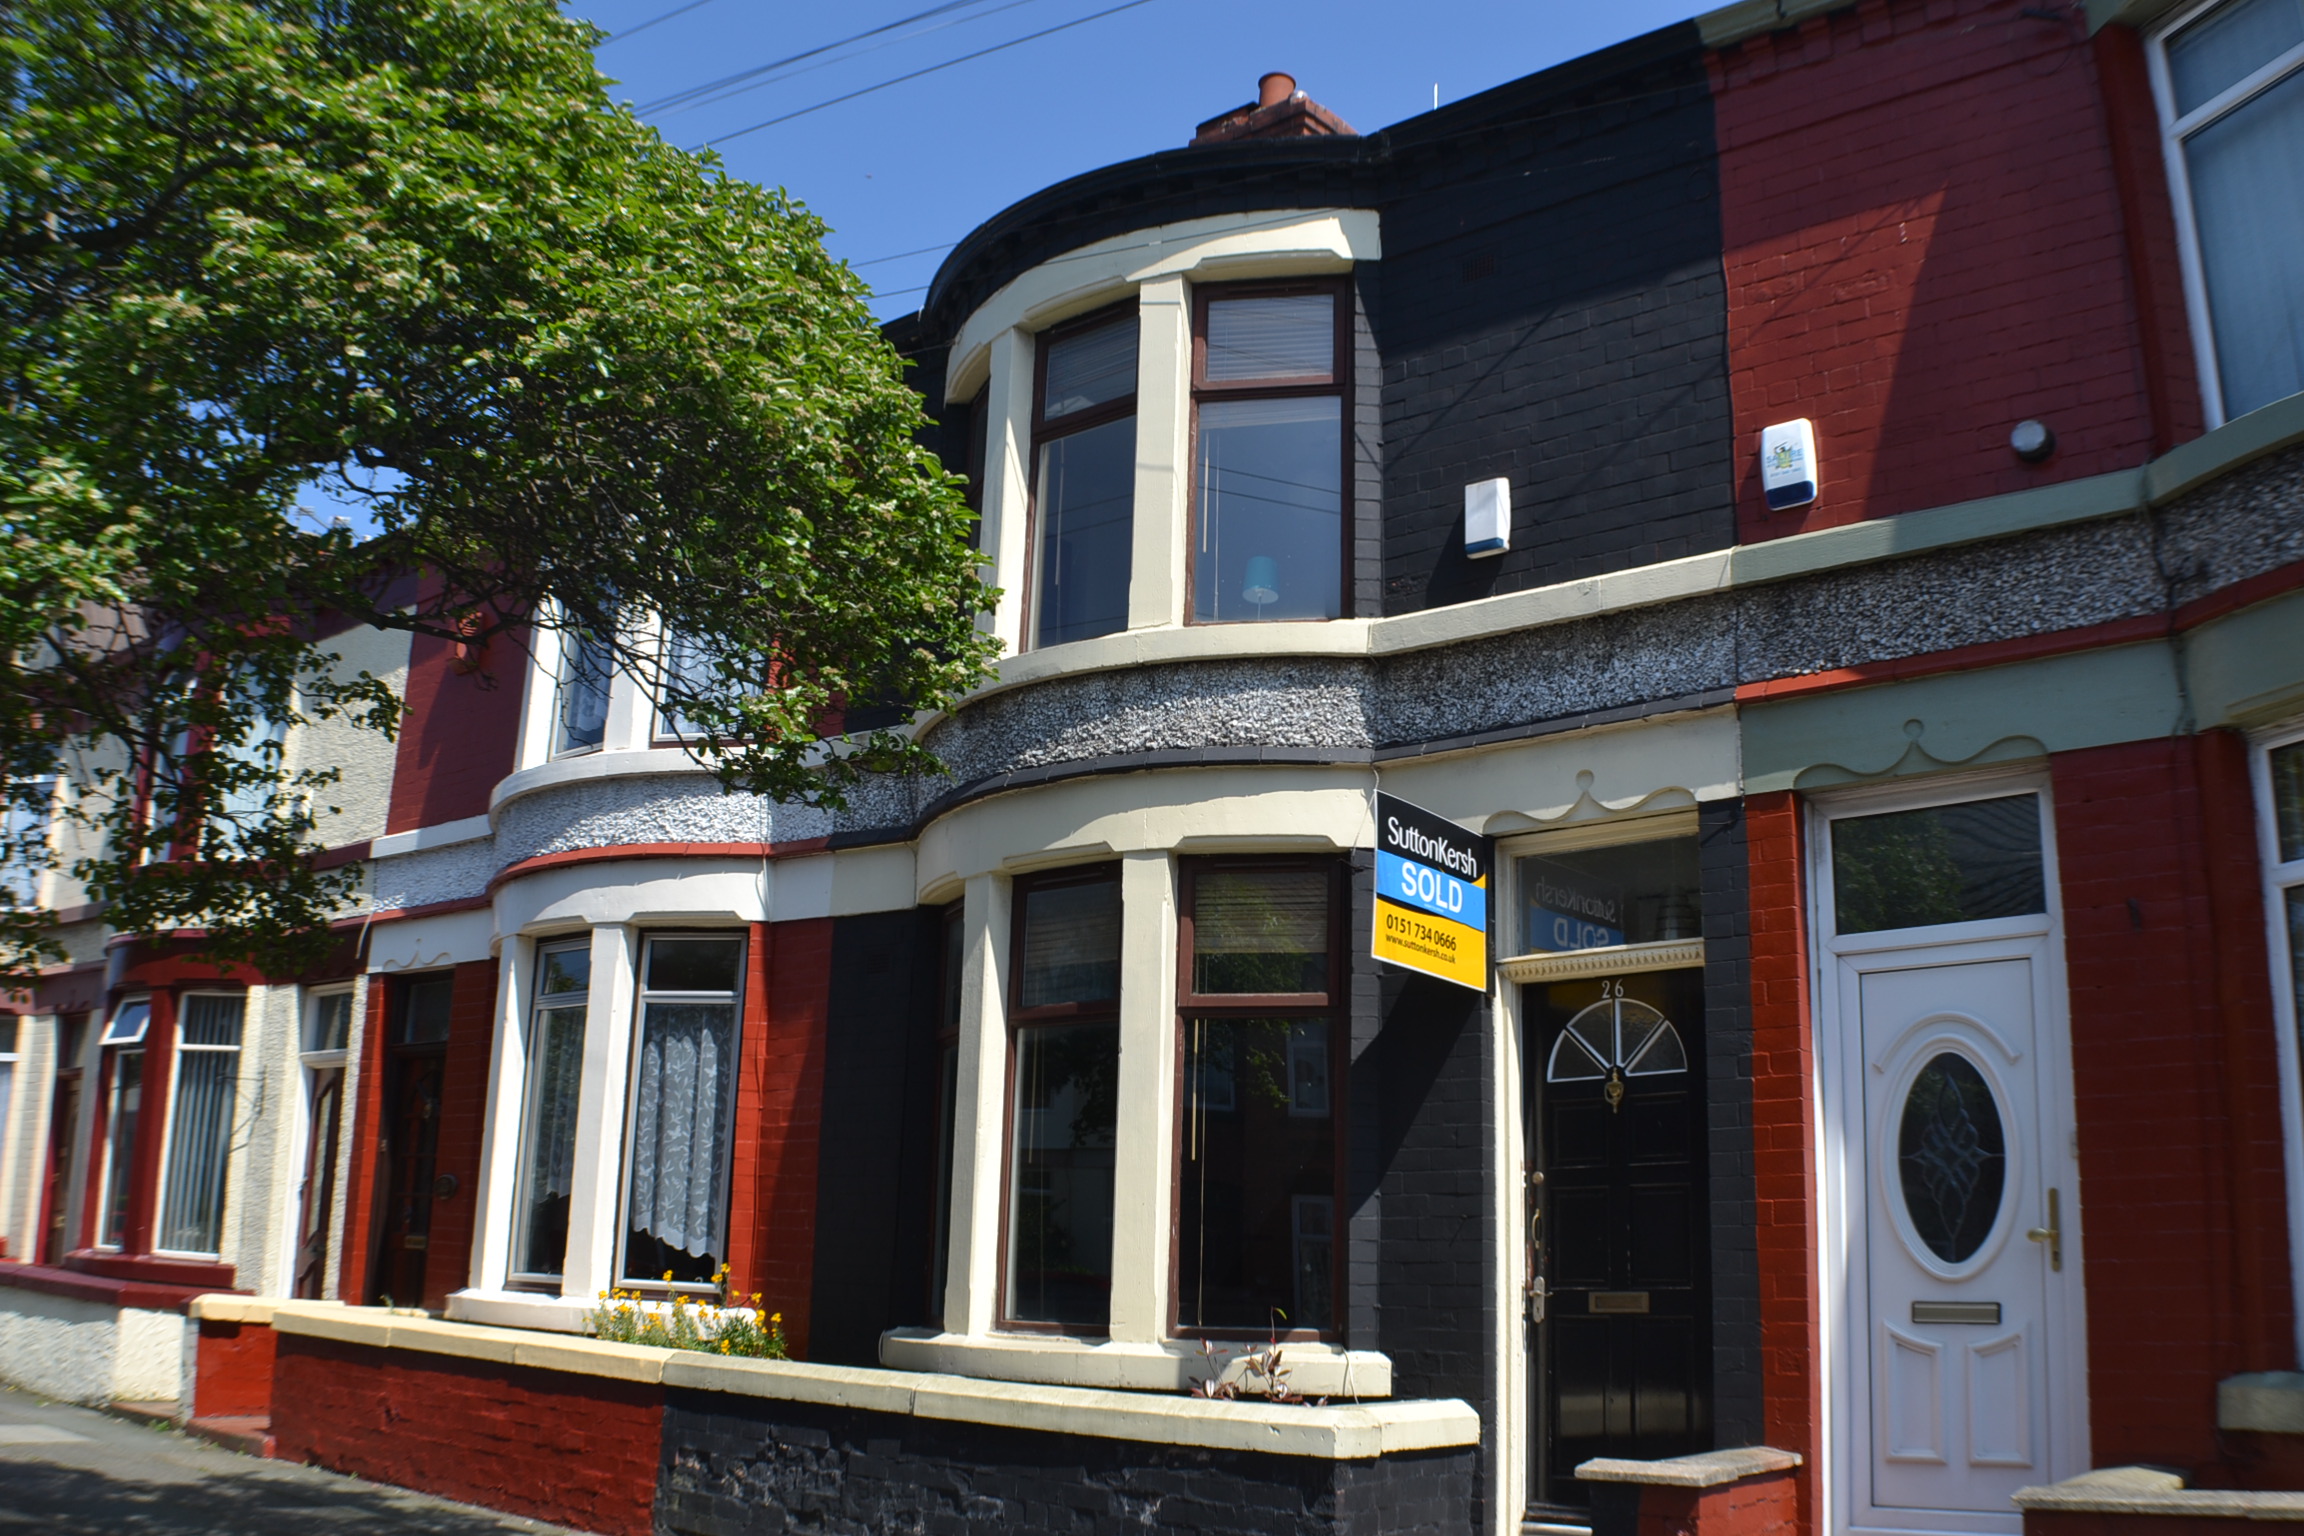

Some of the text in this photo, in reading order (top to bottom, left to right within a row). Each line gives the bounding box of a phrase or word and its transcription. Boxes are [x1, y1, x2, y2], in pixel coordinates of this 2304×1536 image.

[1388, 816, 1477, 878] SuttonKersh
[1401, 861, 1463, 913] SOLD
[1385, 933, 1456, 964] www.suttonkersh.co.uk
[1386, 914, 1457, 951] 0151 734 0666
[1601, 979, 1624, 999] 26
